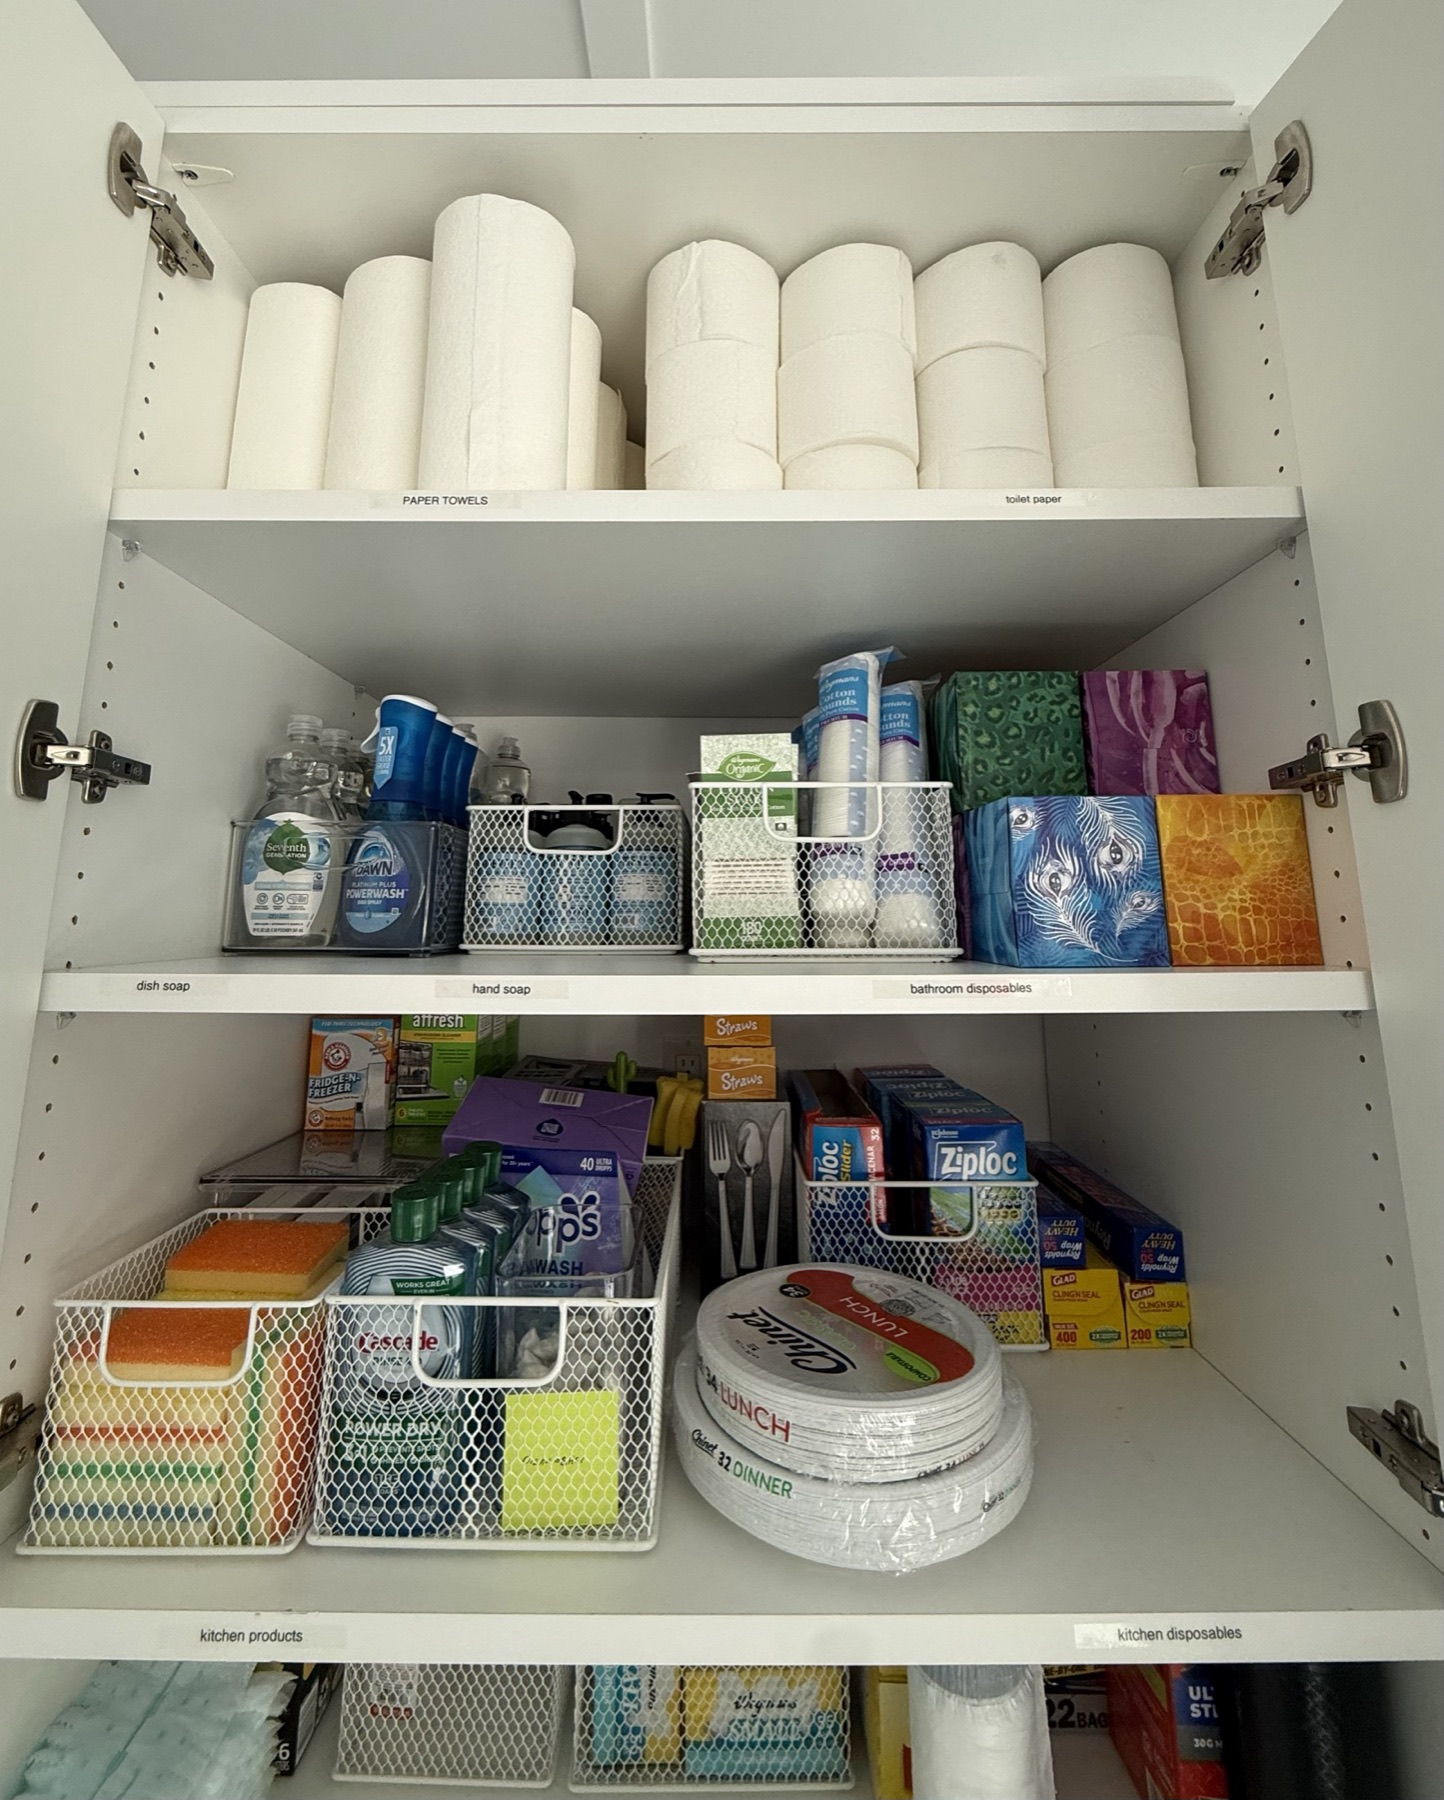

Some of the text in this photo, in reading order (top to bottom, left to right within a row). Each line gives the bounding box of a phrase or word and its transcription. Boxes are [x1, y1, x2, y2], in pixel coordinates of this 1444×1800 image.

[403, 496, 488, 505] PAPER TOWELS
[1006, 495, 1062, 504] toilet paper
[379, 736, 395, 756] 5X
[726, 763, 765, 779] Organic
[357, 860, 394, 876] DAWN
[136, 980, 191, 992] dish soap
[472, 983, 531, 996] hand soap
[910, 983, 1032, 995] bathroom disposables
[412, 1013, 464, 1029] affresh
[716, 1018, 758, 1036] Straws
[309, 1073, 360, 1089] FRIDGE-N-
[721, 1073, 764, 1090] Straws
[308, 1083, 352, 1098] FREEZER
[911, 1091, 965, 1099] Ziploc
[933, 1107, 993, 1115] Ziploc
[871, 1128, 880, 1141] 32
[580, 1157, 595, 1172] 40
[596, 1158, 613, 1166] ULTRA
[840, 1139, 852, 1181] Slider
[941, 1146, 1017, 1181] Ziploc
[1044, 1228, 1079, 1237] HEAVY
[1043, 1241, 1057, 1251] 50
[1060, 1240, 1082, 1250] Wrap
[1141, 1240, 1177, 1250] HEAVY
[1044, 1250, 1081, 1260] Reynolds
[1140, 1254, 1154, 1264] 50
[1157, 1253, 1179, 1264] Wrap
[1141, 1263, 1178, 1274] Reynolds
[425, 1279, 450, 1288] GREAT
[1053, 1274, 1075, 1286] GLAD
[1082, 1291, 1101, 1299] SEAL
[1131, 1287, 1154, 1300] GLAD
[840, 1296, 909, 1338] LUNCH
[727, 1307, 850, 1375] Chinet
[1056, 1331, 1077, 1343] 400
[1131, 1329, 1152, 1340] 200
[885, 1352, 931, 1382] COMPOSTABLE
[721, 1381, 790, 1443] LUNCH
[345, 1421, 440, 1437] POWER DRY
[691, 1429, 793, 1499] Chinet 32 DINNER
[200, 1629, 303, 1644] kitchen products
[1118, 1626, 1242, 1642] kitchen disposables
[1188, 1685, 1214, 1701] UL
[278, 1743, 290, 1760] 6
